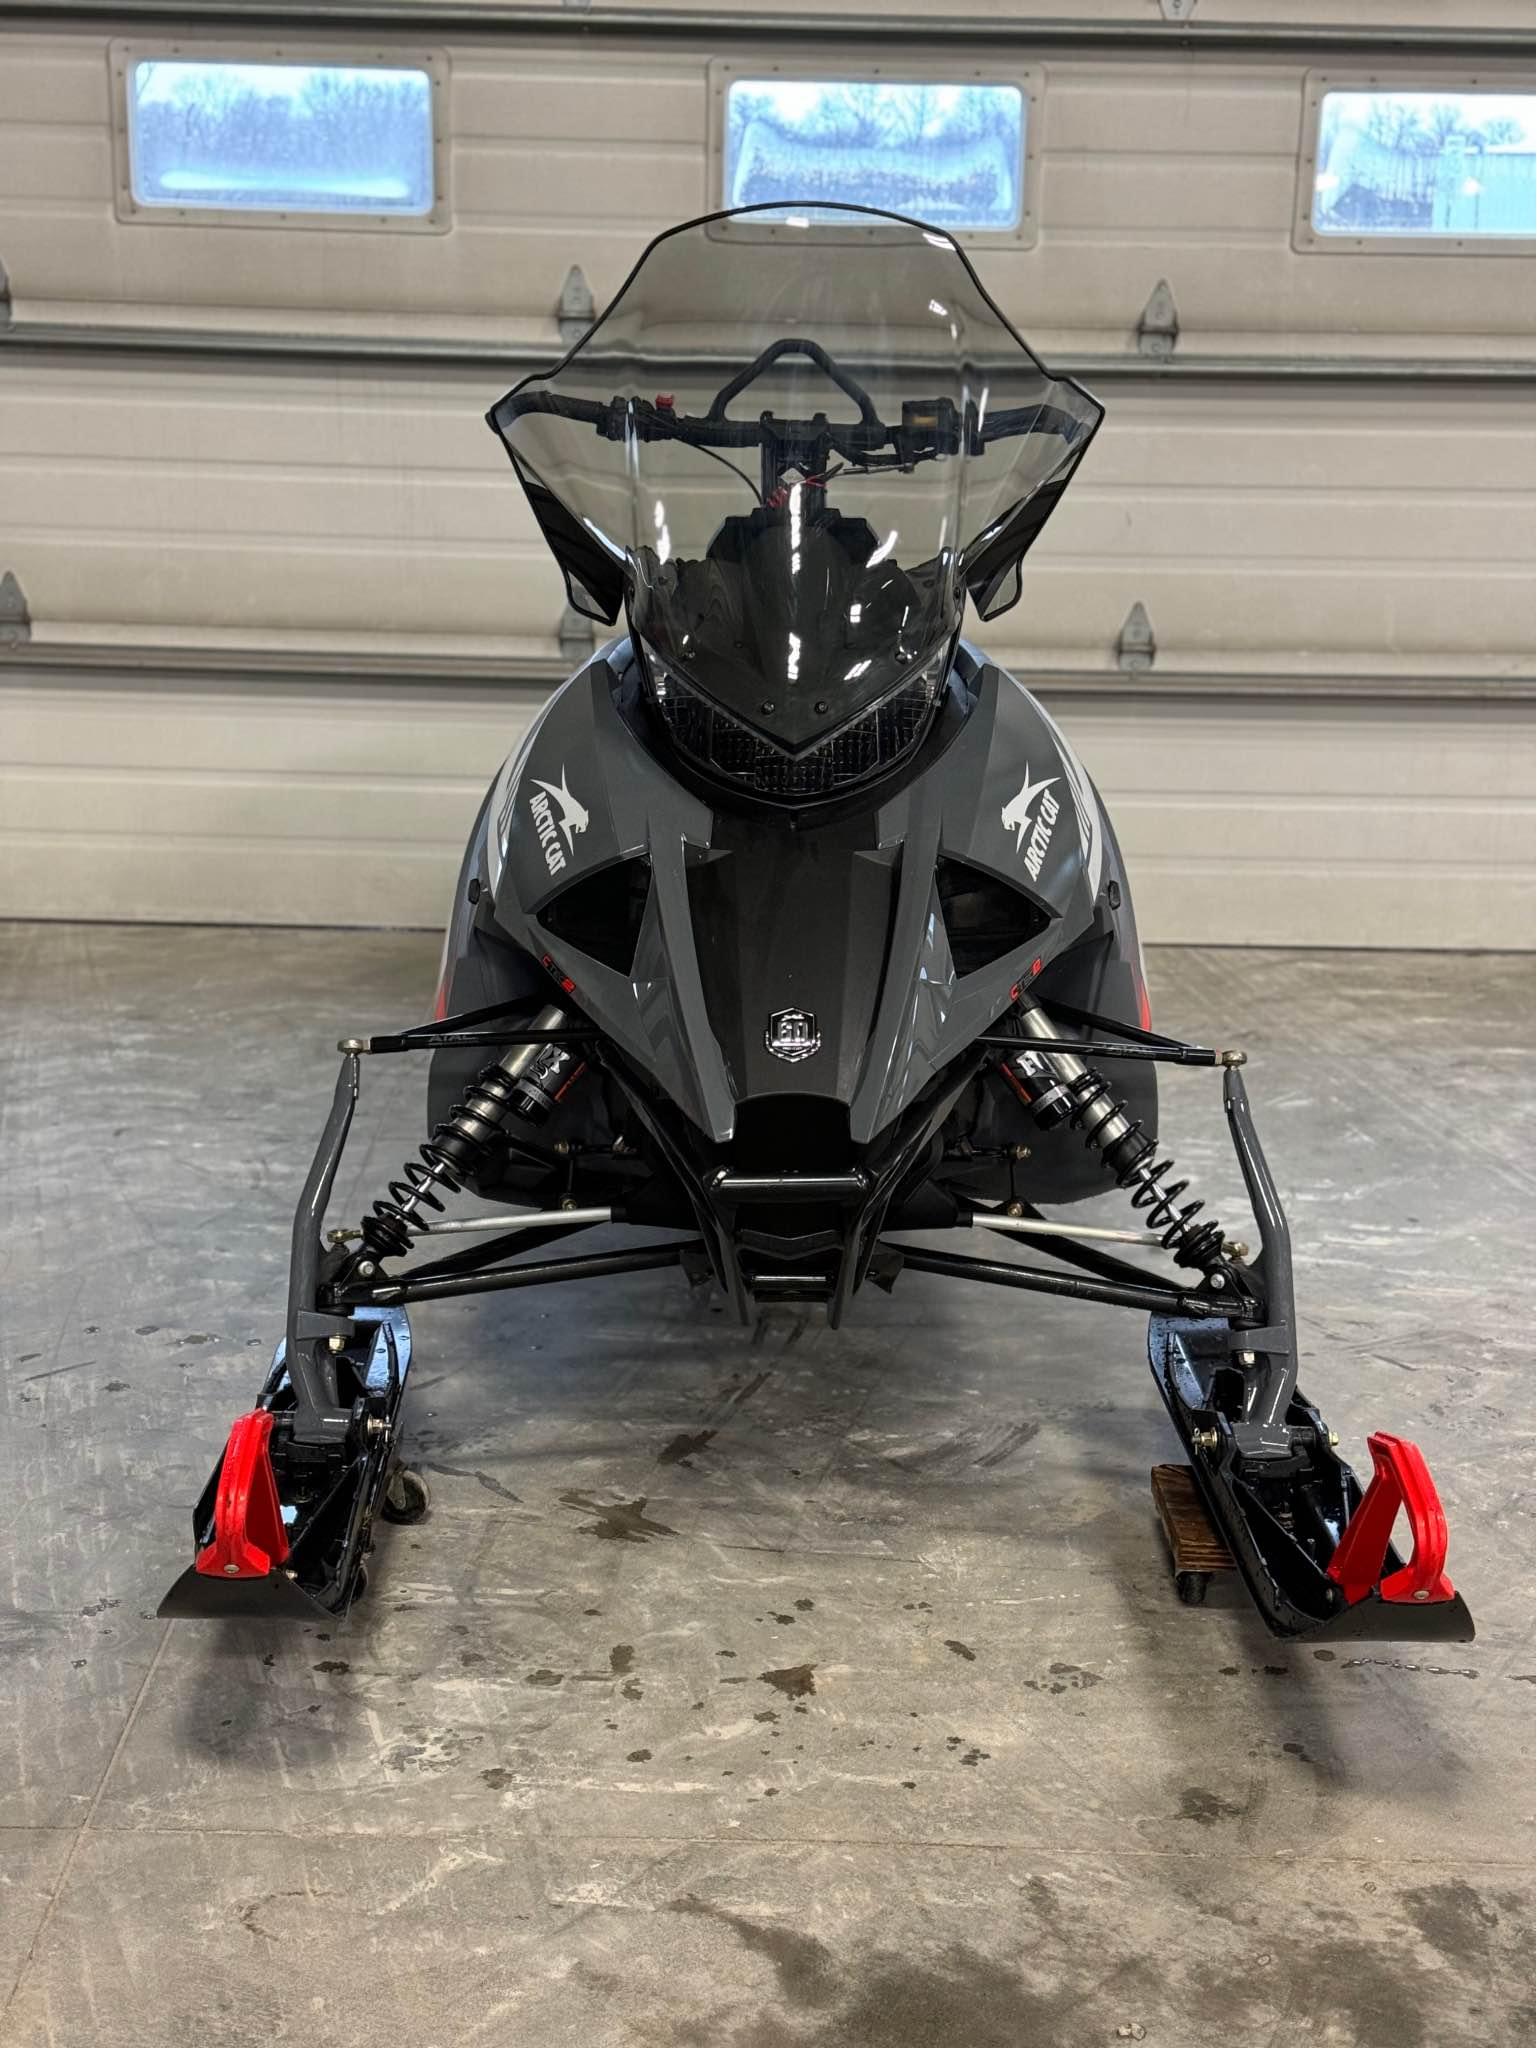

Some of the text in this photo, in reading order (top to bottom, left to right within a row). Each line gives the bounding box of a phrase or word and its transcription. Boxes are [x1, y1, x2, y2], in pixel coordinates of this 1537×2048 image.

[529, 791, 567, 876] ARCTIC CAT
[1024, 788, 1060, 882] ARCTIC CAT
